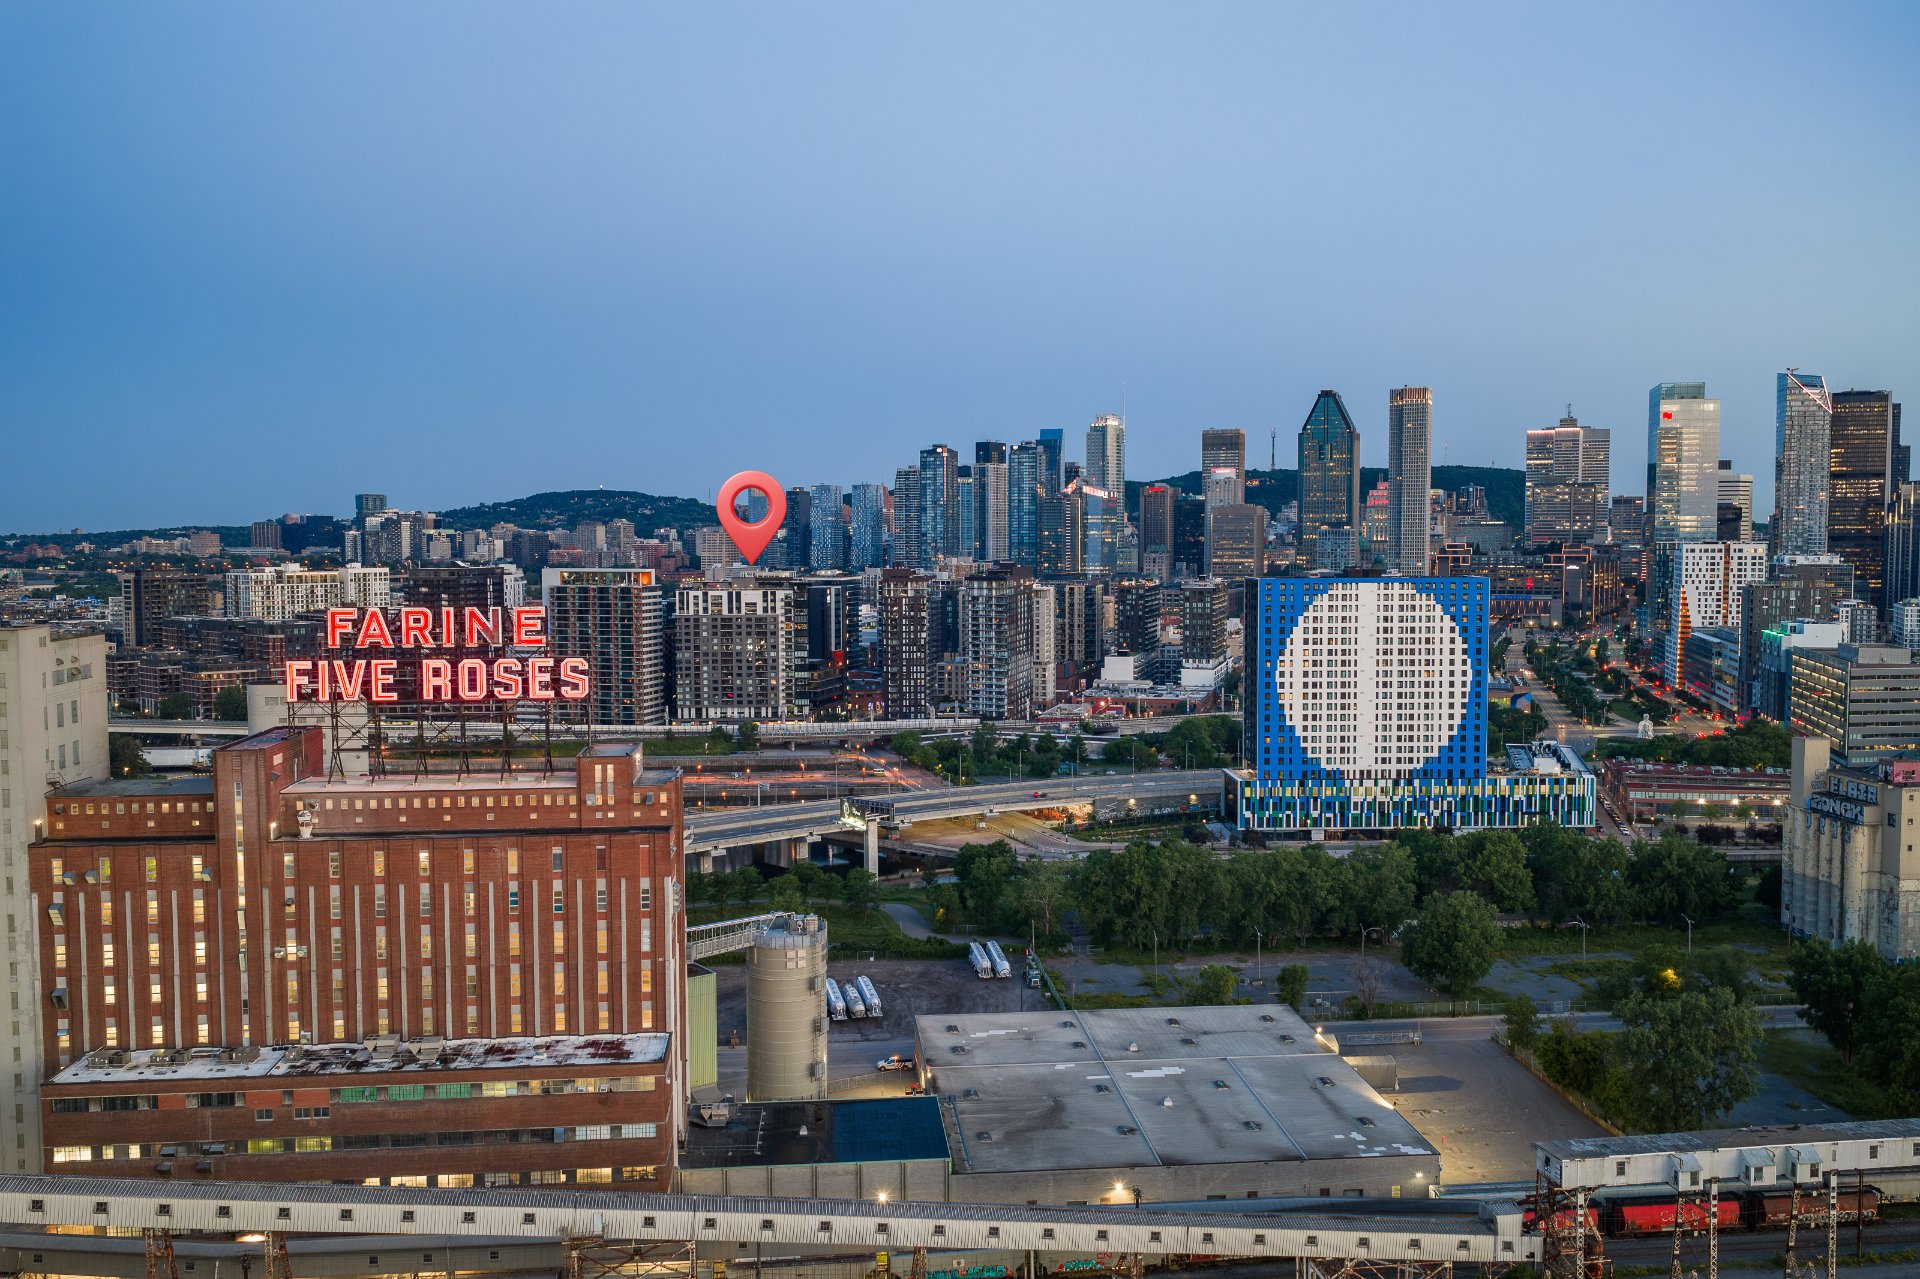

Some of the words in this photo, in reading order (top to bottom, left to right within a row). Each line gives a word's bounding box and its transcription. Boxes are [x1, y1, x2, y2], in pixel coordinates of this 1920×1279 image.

[327, 606, 547, 649] FARINE
[285, 659, 399, 702] FIVE
[422, 657, 590, 701] ROSES
[1096, 1252, 1113, 1260] CN
